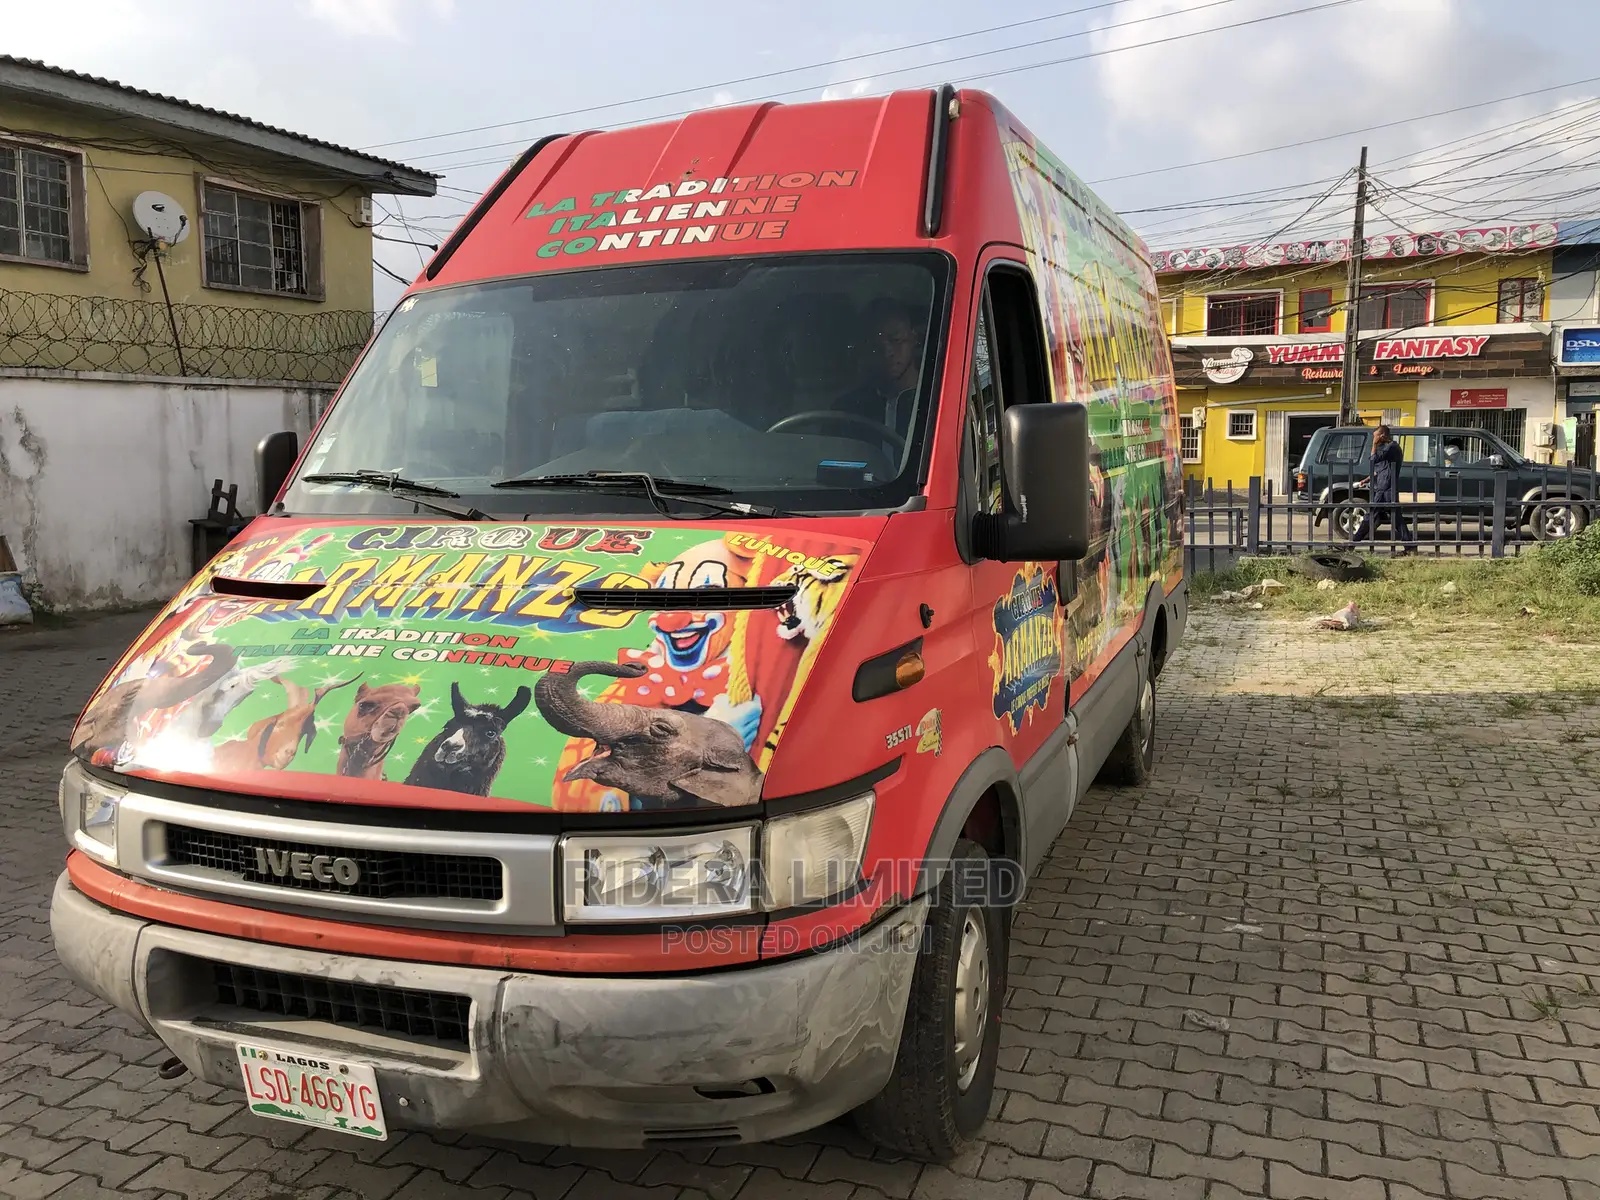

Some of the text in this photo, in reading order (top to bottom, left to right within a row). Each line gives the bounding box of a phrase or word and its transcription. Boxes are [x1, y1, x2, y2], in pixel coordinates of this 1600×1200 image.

[524, 169, 859, 220] LA TRADITION
[548, 194, 801, 235] ITALIENNE
[536, 219, 789, 259] CONTINUE
[1373, 335, 1490, 360] FANTASY
[1301, 363, 1434, 380] Restaura & Lounge
[346, 525, 655, 555] CIRQUE
[728, 534, 839, 577] L'UNIQUE
[291, 627, 519, 648] LA TRADITION
[231, 643, 575, 674] ITALIENNE CONTINUE
[256, 847, 362, 886] IVECO
[276, 1053, 330, 1070] LAGOS
[243, 1063, 377, 1121] LSD-466YG
